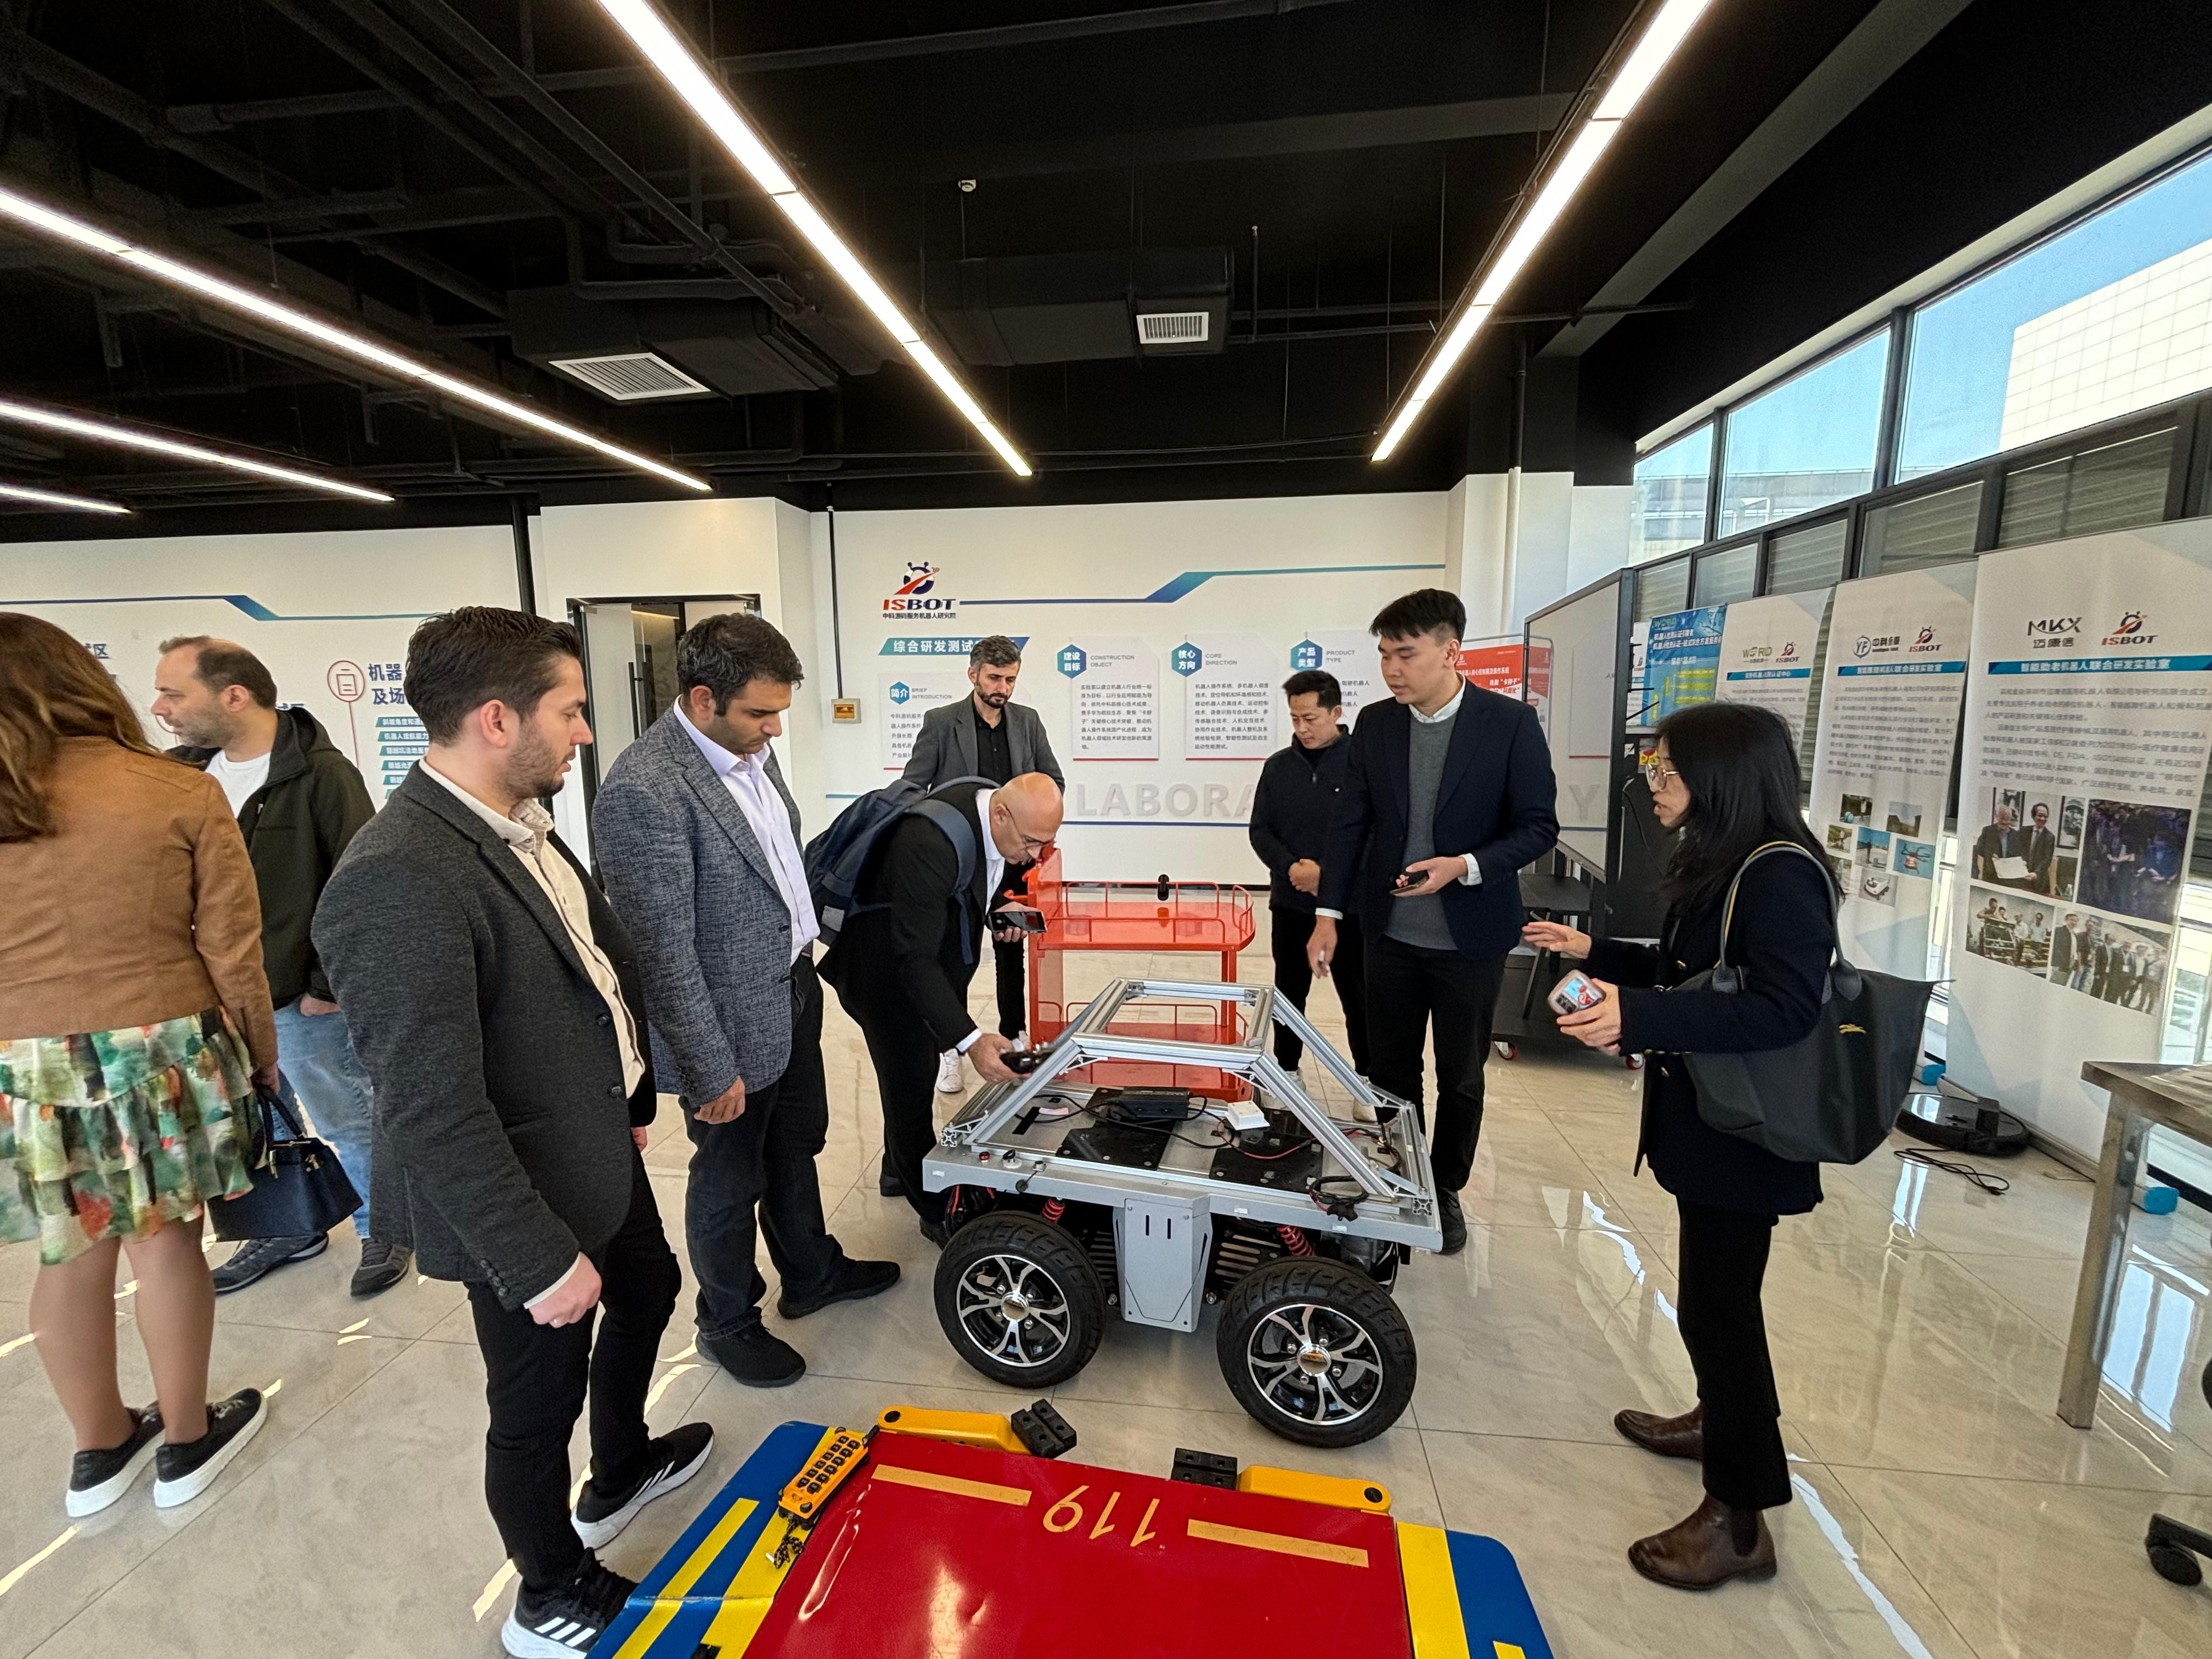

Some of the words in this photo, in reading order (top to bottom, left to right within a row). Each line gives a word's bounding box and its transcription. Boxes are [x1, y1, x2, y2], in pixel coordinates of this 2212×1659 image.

[882, 599, 957, 611] ISBOT
[2027, 617, 2083, 636] MKX
[2101, 635, 2158, 646] ISBOT
[85, 643, 110, 659] 区
[893, 640, 979, 653] 综合研发测试
[1298, 647, 1316, 657] 产品
[1063, 652, 1081, 661] 建设
[1178, 650, 1196, 659] 核心
[1064, 663, 1081, 672] 目标
[1178, 661, 1196, 670] 方向
[368, 663, 403, 681] 机器
[371, 687, 405, 705] 及场
[890, 688, 909, 698] 简介
[1042, 1485, 1160, 1548] 119
